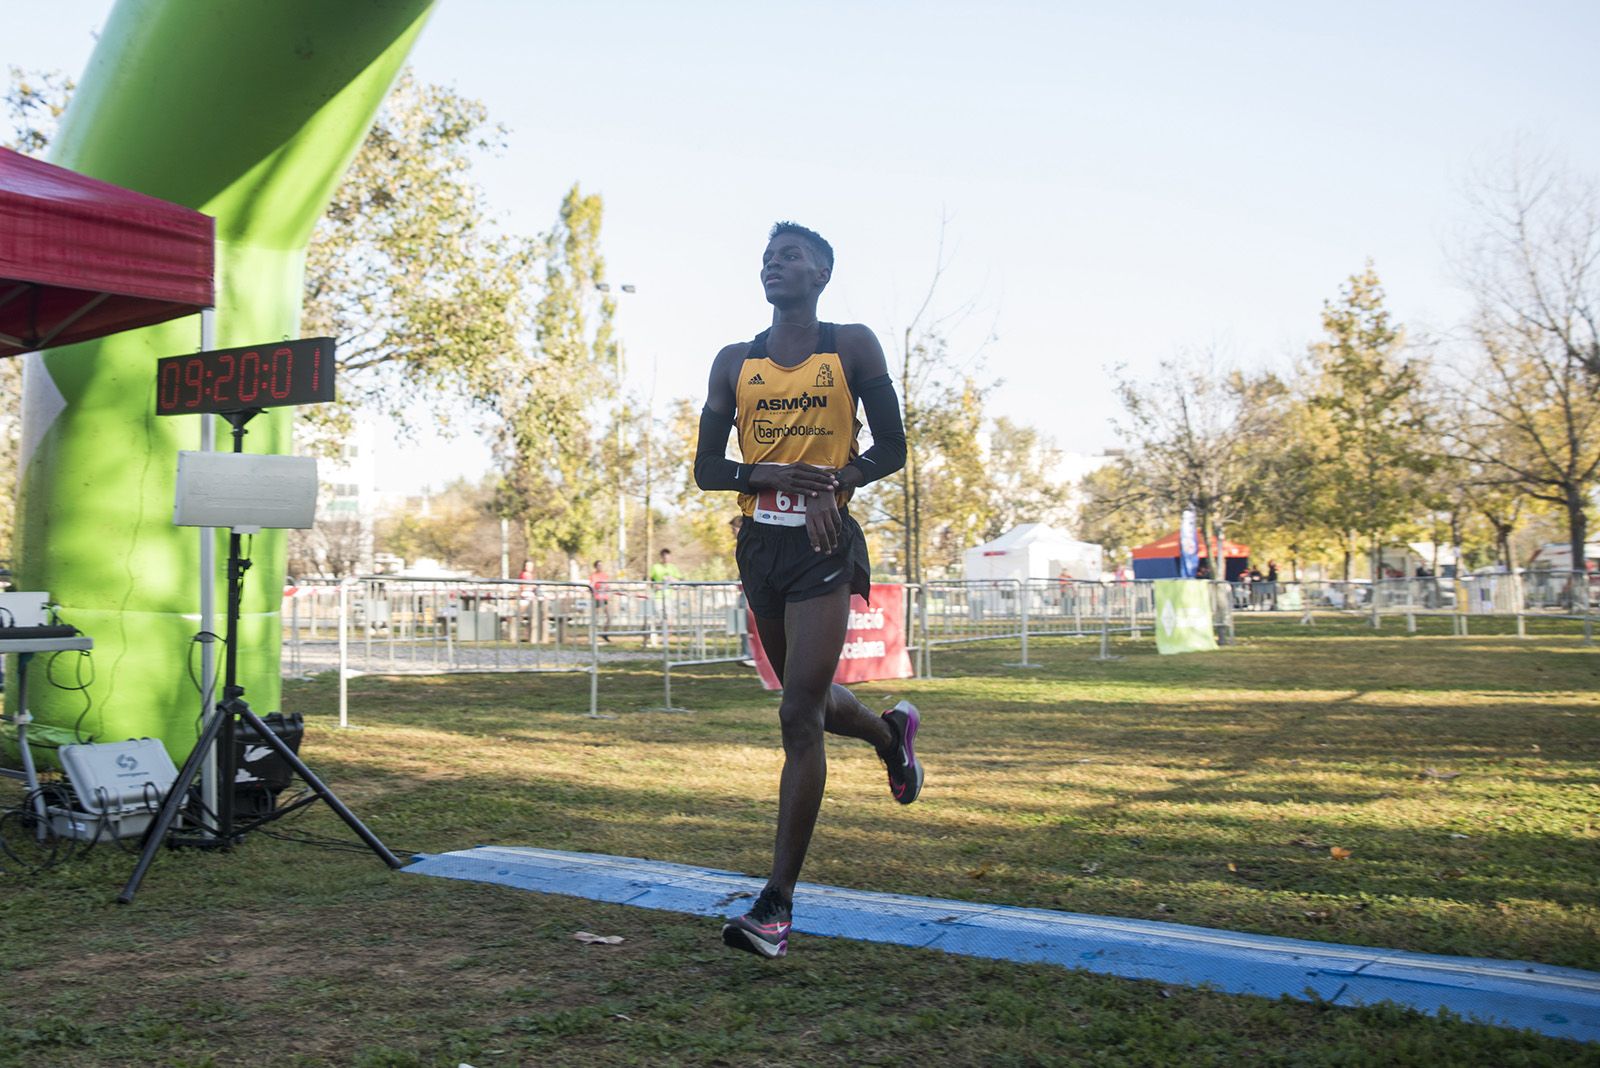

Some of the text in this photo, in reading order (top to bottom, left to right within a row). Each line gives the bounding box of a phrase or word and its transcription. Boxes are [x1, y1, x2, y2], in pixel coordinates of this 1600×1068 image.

[160, 347, 321, 410] 09:20:01
[847, 608, 884, 630] tació
[840, 637, 886, 660] celona
